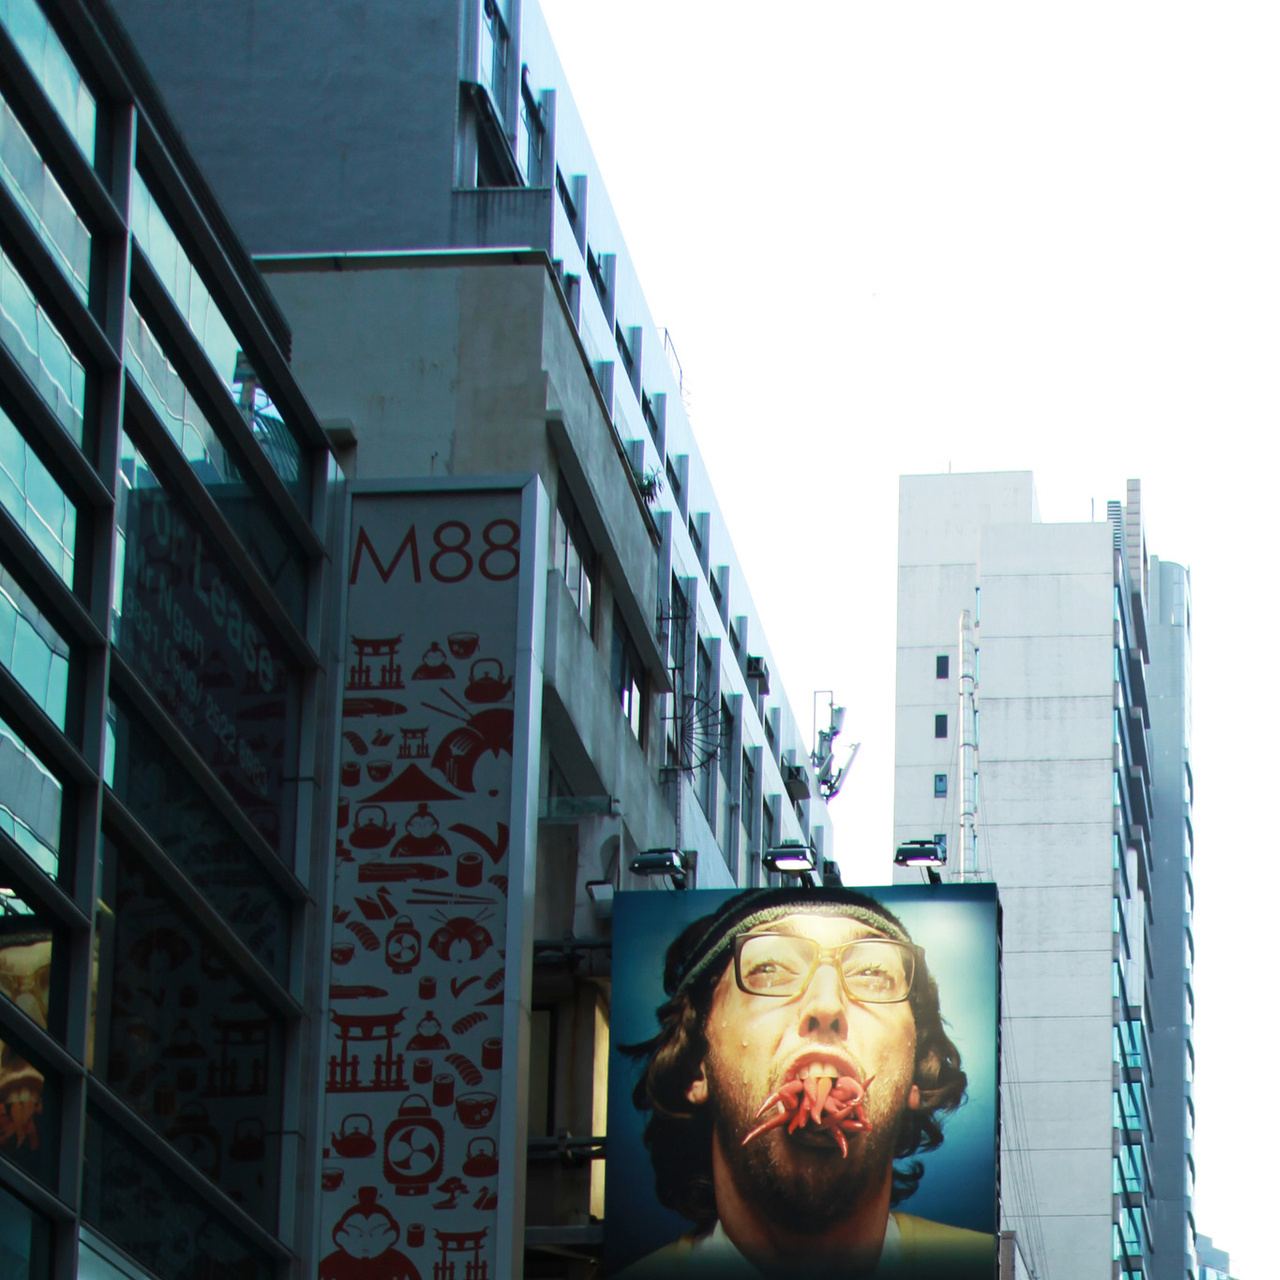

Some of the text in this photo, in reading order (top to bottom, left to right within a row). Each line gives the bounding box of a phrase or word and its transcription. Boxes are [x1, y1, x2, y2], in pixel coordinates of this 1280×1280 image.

[350, 518, 520, 585] M88
[159, 571, 206, 667] Ngan
[194, 530, 273, 692] Lease
